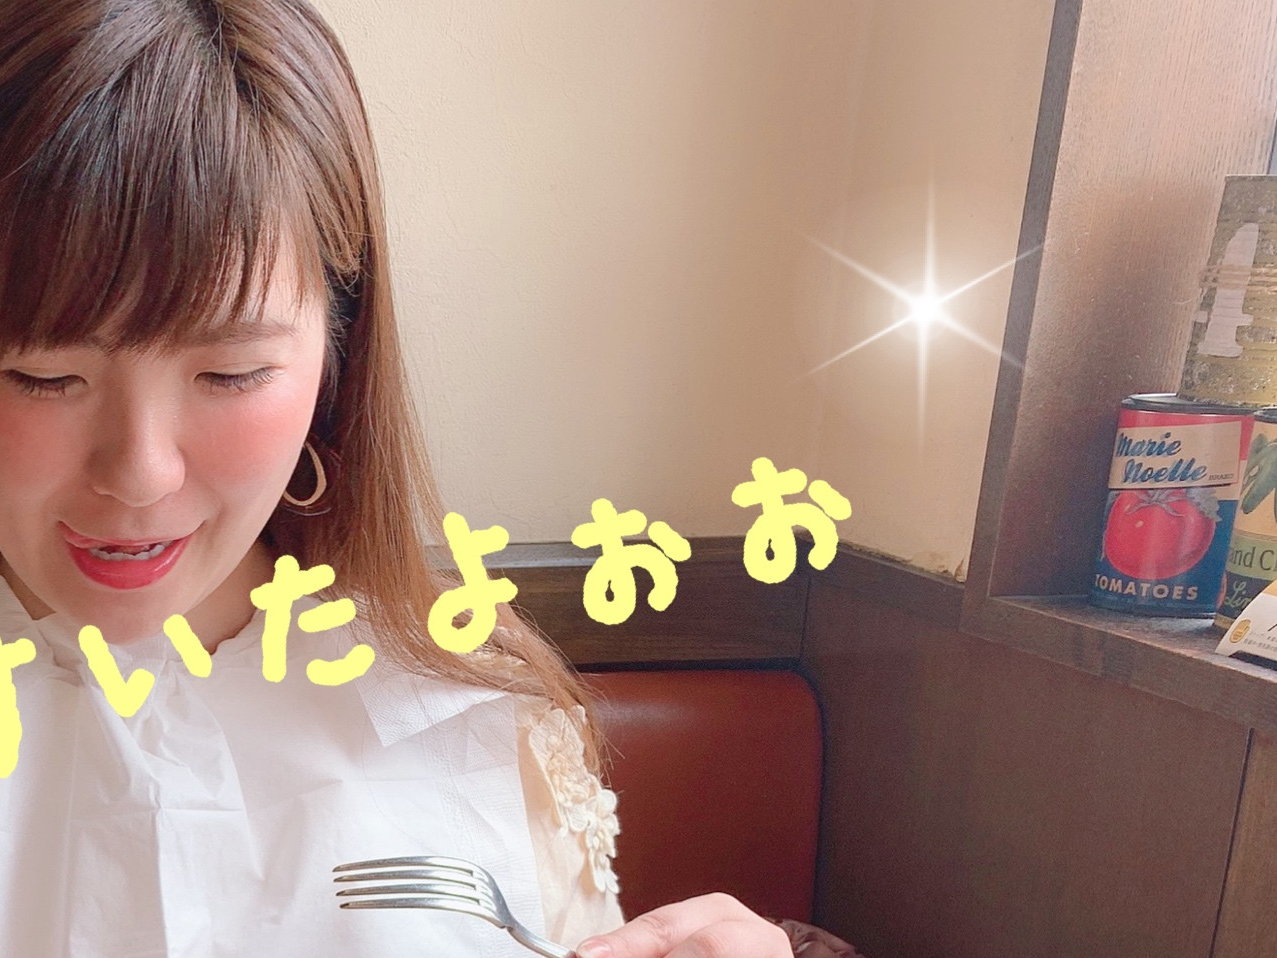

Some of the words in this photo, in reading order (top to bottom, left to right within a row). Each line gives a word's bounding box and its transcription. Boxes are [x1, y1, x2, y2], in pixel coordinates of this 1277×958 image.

[1116, 431, 1181, 457] Marie
[1123, 457, 1207, 484] Noelle
[1259, 549, 1277, 571] C
[1095, 574, 1199, 601] TOMATOES
